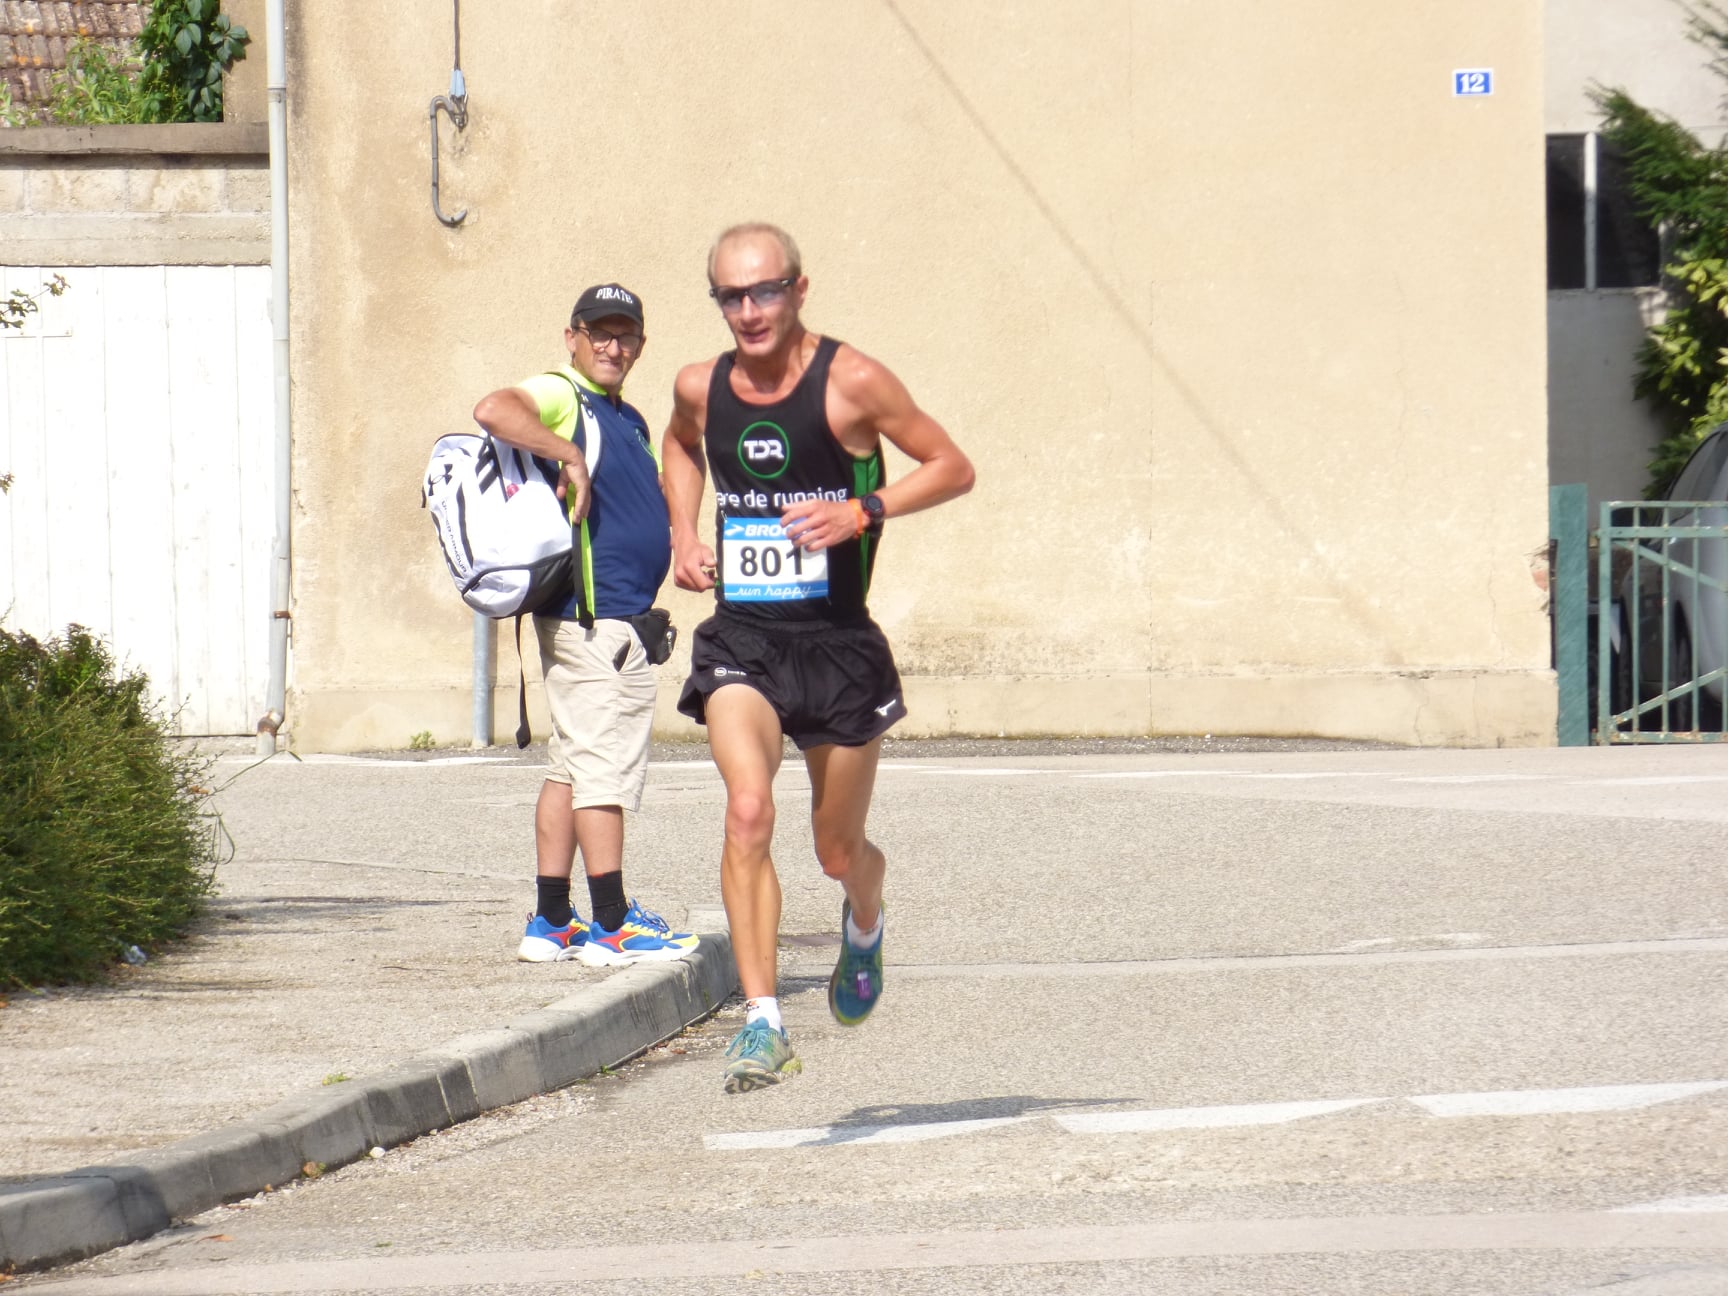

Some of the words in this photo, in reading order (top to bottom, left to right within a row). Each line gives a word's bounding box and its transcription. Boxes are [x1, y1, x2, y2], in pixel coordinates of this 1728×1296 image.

[1460, 73, 1485, 93] 12
[743, 439, 785, 460] TDR
[743, 489, 768, 508] de
[740, 545, 803, 577] 801
[764, 584, 811, 600] happy
